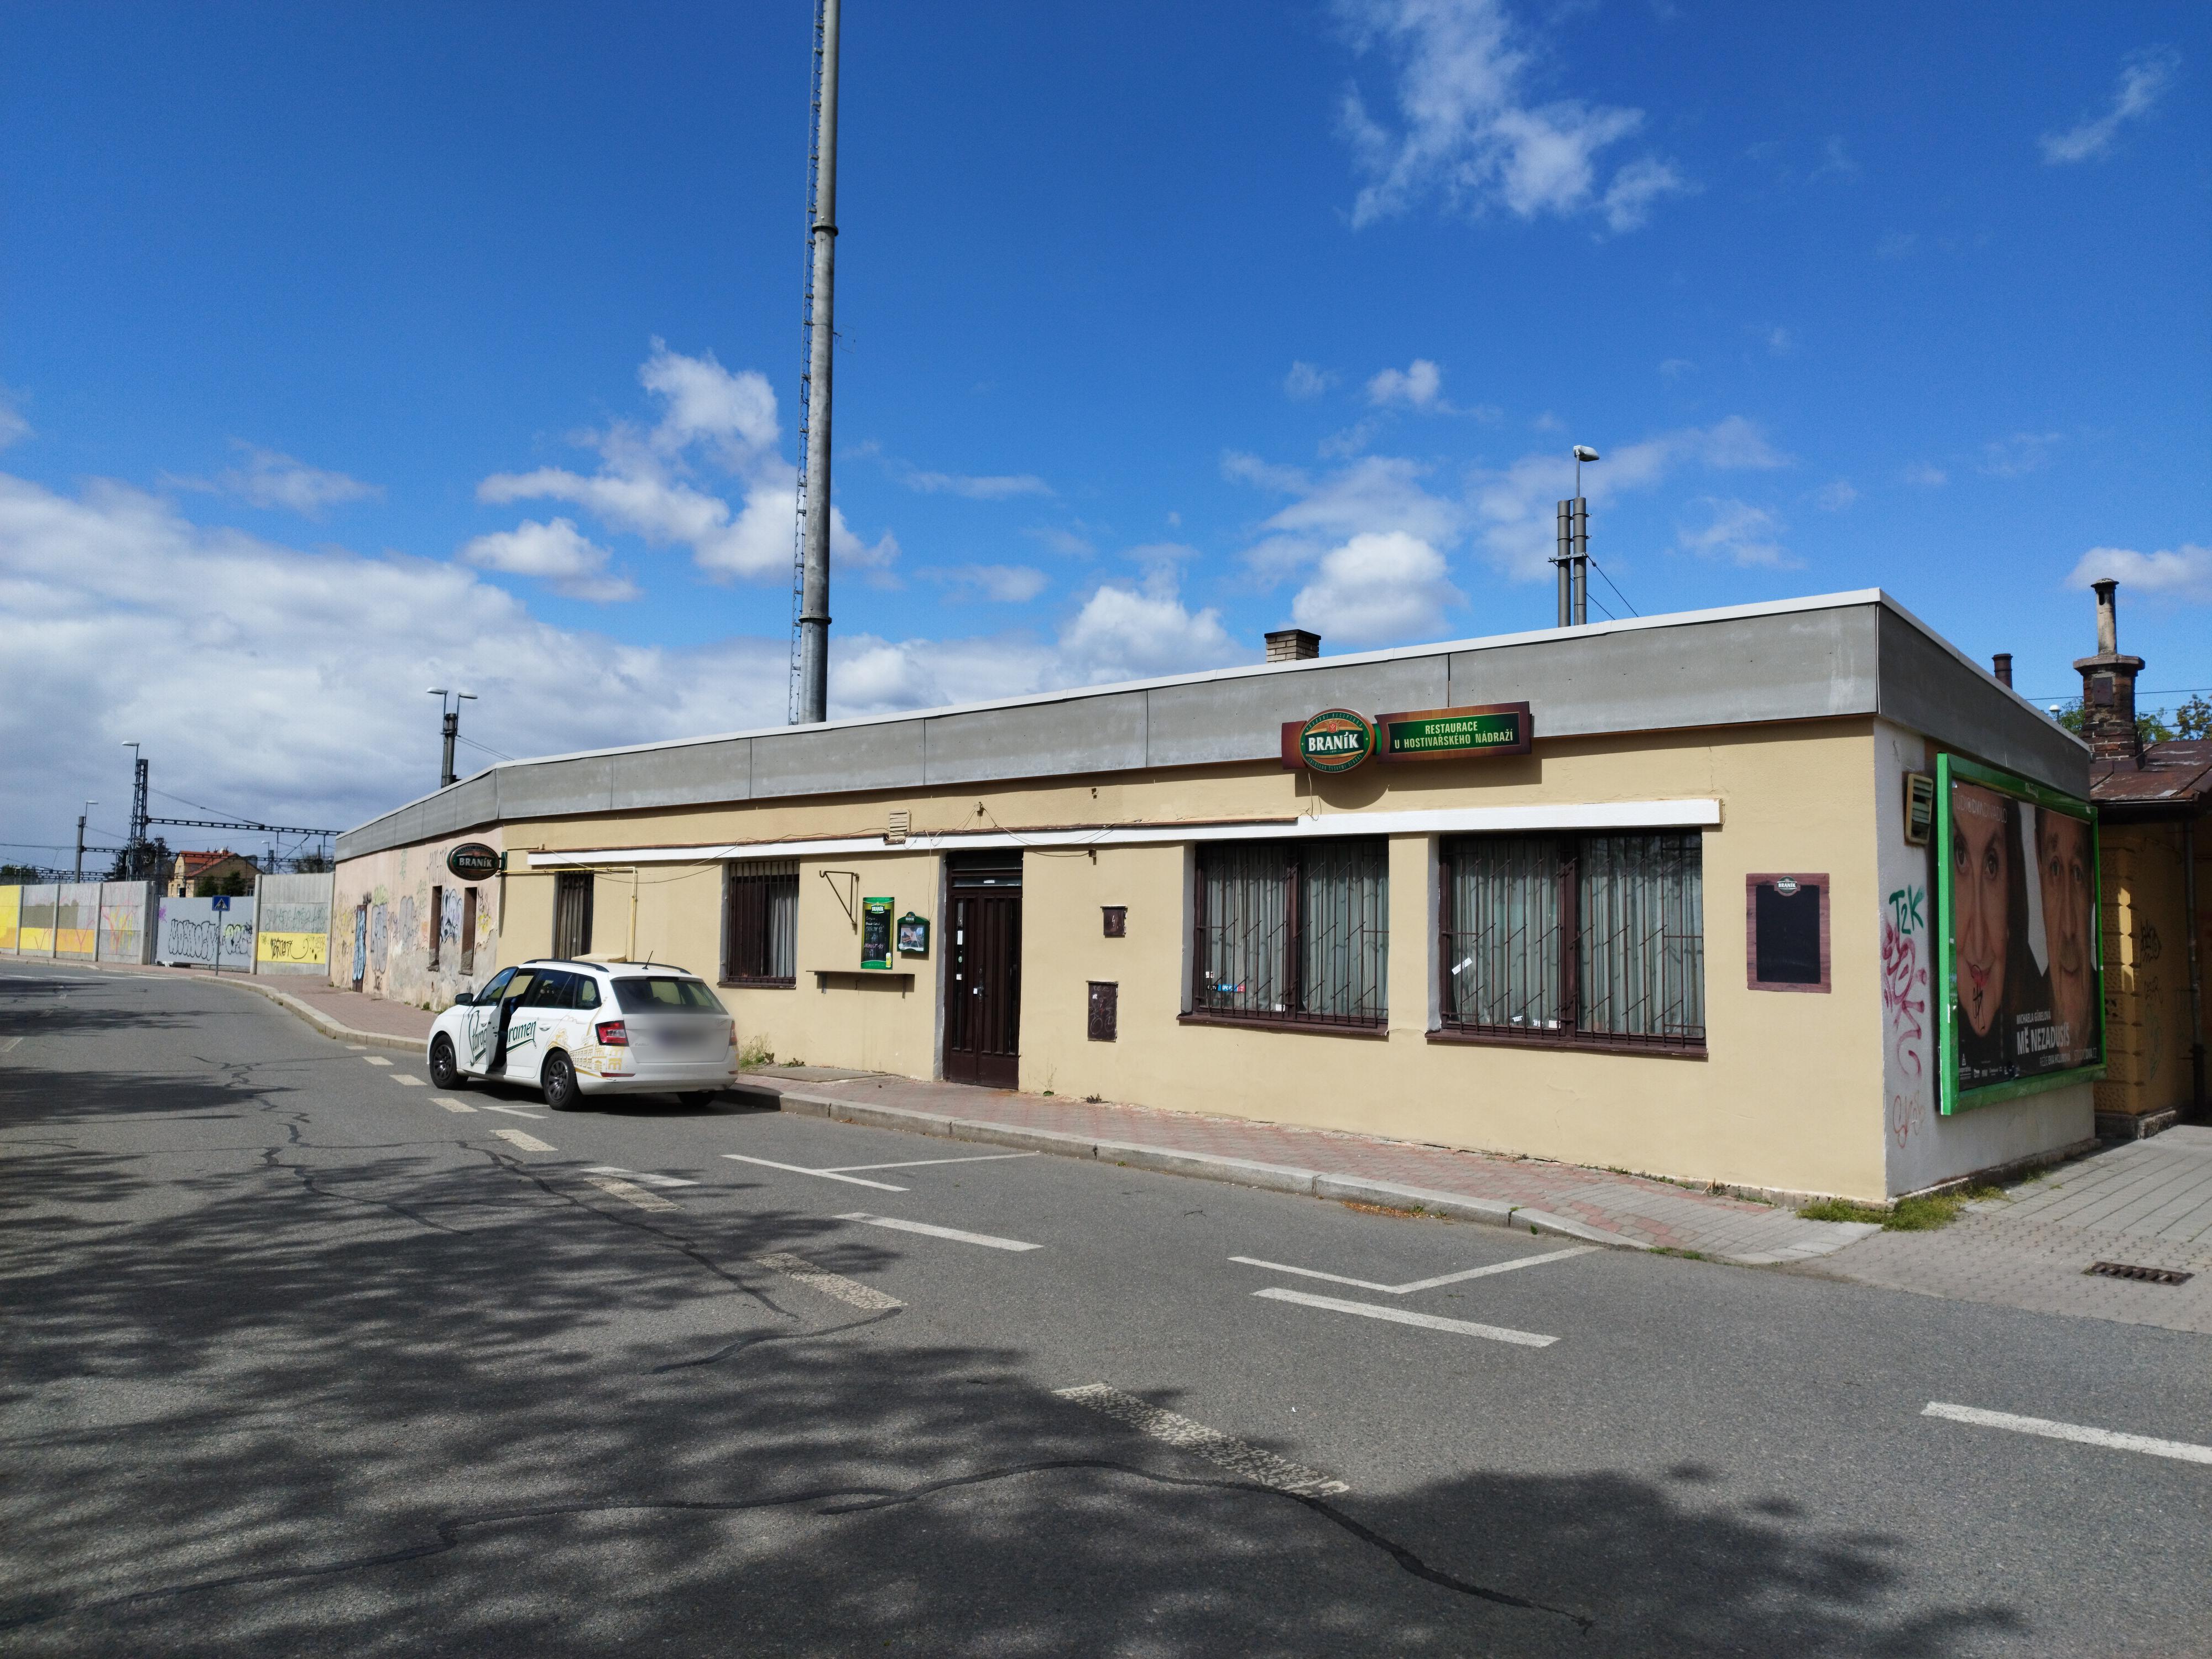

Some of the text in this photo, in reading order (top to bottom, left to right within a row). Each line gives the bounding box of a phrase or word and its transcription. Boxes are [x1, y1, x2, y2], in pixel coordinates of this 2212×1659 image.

[1425, 721, 1478, 735] RESTAURACE
[1308, 732, 1359, 752] BRANÍK
[1395, 728, 1513, 749] U HOSTIVAŘSKÉHO NÁDRAŽÍ
[459, 858, 492, 868] BRANÍK
[2017, 1026, 2030, 1055] MĚ
